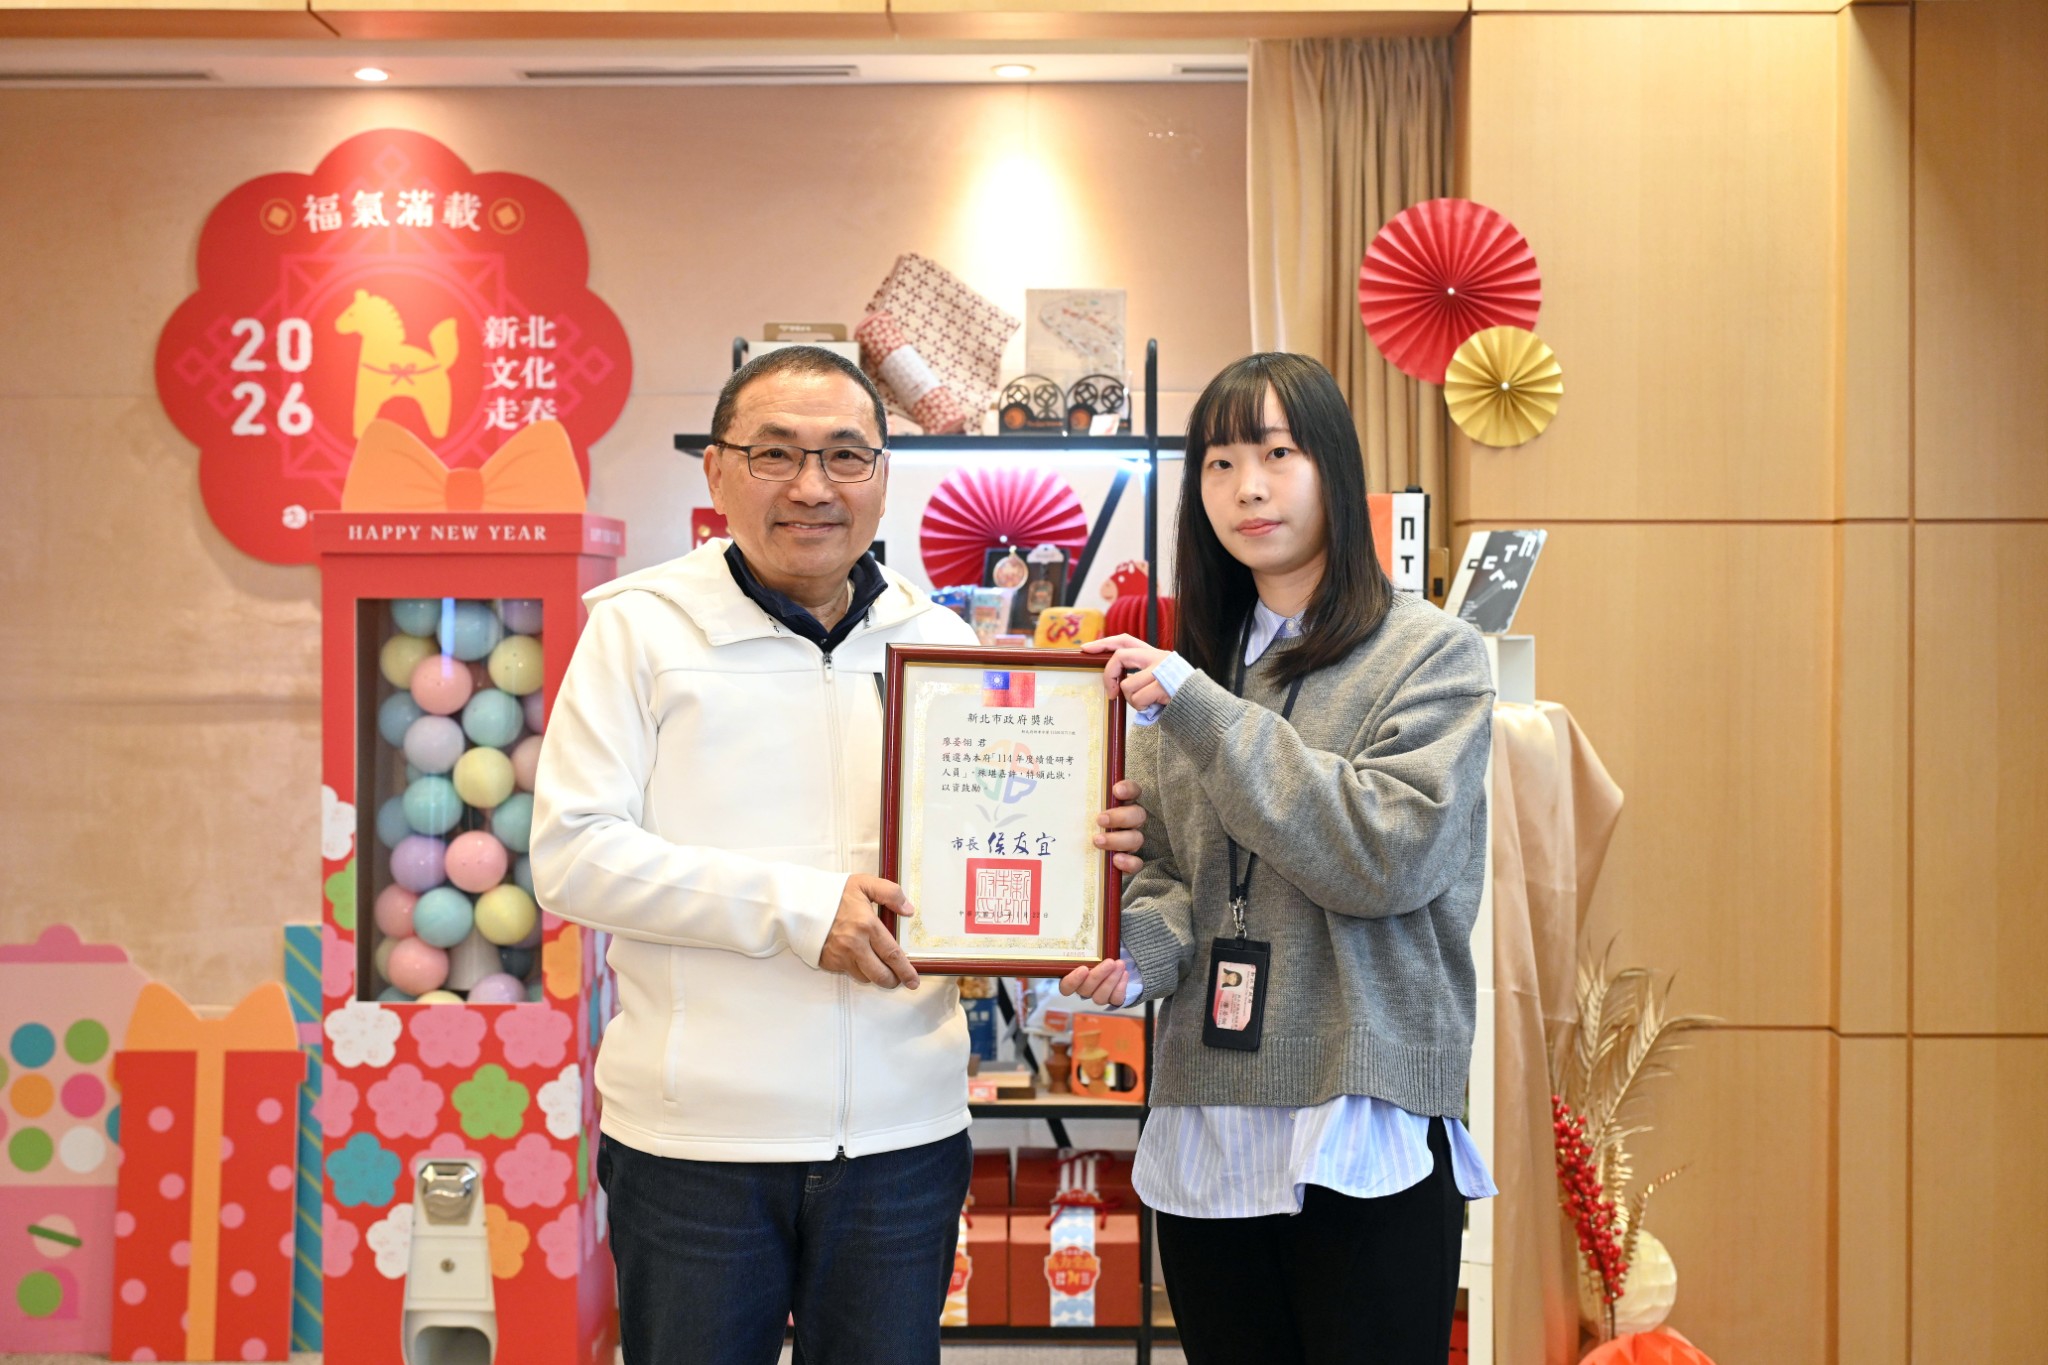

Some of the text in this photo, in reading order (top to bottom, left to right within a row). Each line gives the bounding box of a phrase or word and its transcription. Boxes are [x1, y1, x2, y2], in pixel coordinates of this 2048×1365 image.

[302, 189, 482, 233] 福氣滿載
[230, 318, 313, 372] 20
[483, 315, 557, 350] 新北
[483, 356, 557, 391] 文化
[230, 382, 314, 436] 26
[348, 524, 548, 541] HAPPY NEW YEAR
[967, 712, 1055, 726] 新北市政府獎狀
[977, 738, 987, 748] 君
[951, 836, 979, 851] 市長
[987, 831, 1056, 856] 侯友宜
